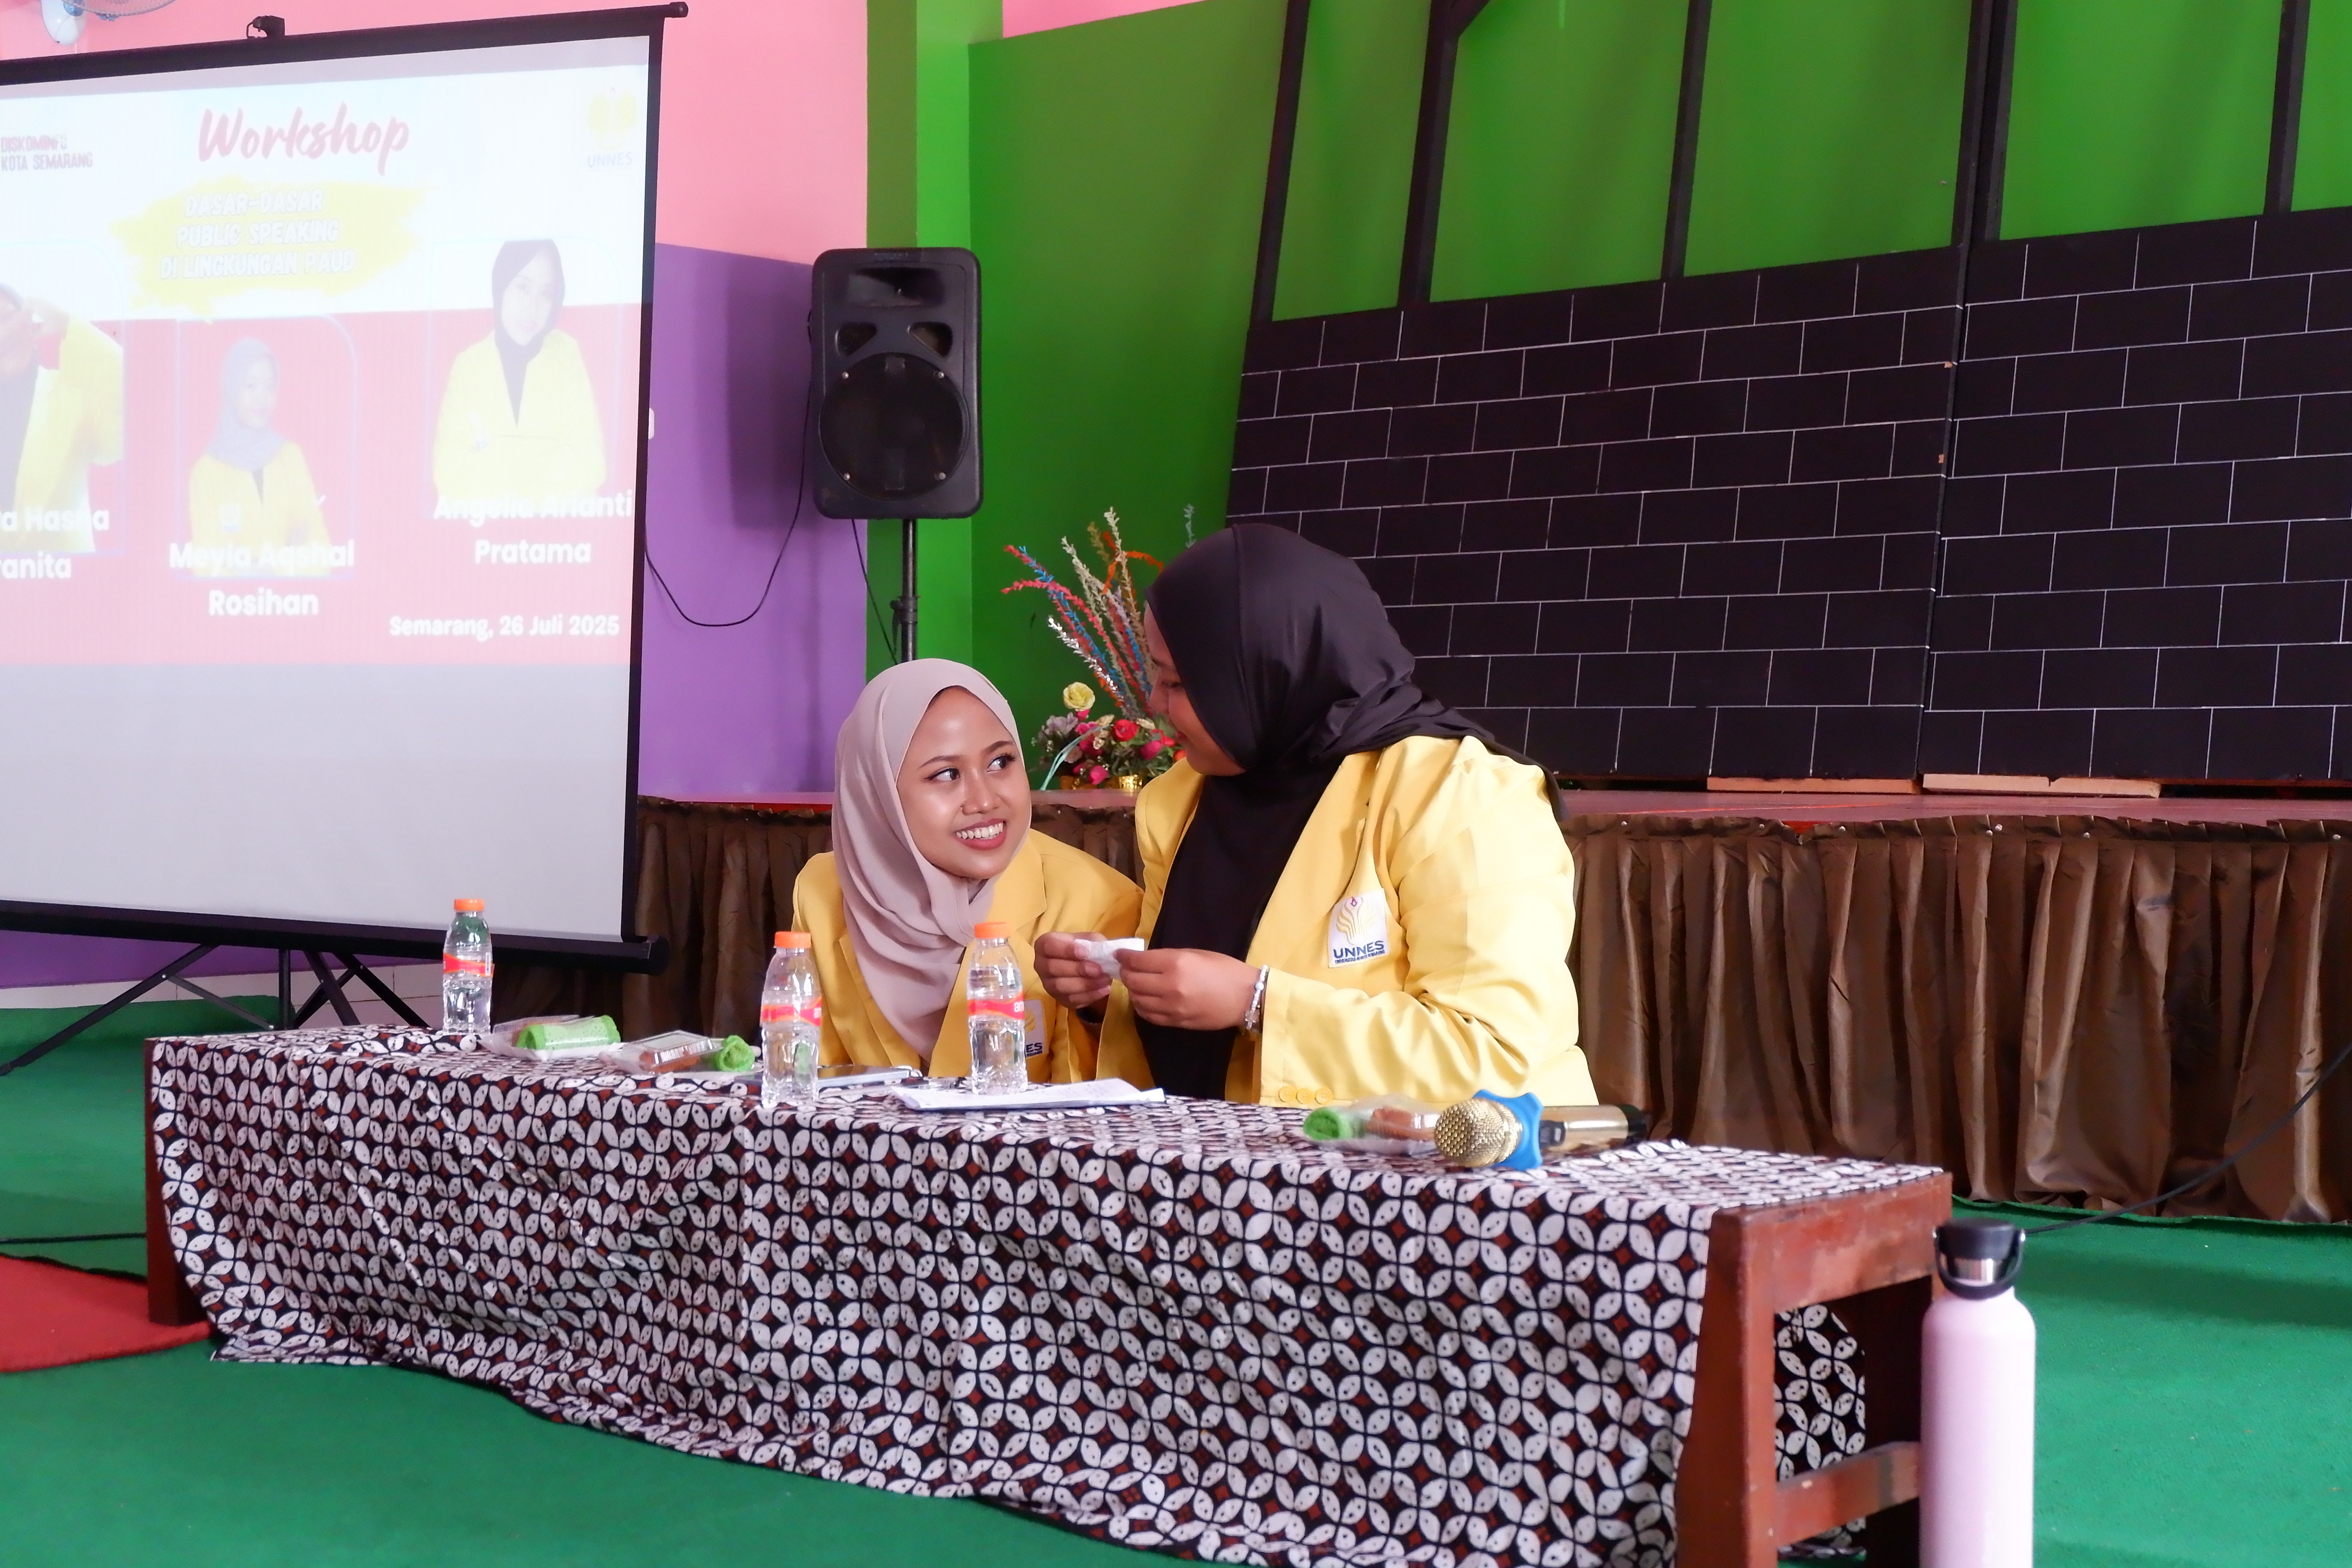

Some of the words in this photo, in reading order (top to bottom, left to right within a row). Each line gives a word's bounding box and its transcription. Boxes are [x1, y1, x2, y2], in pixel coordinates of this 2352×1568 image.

[198, 101, 410, 176] Workshop
[1, 155, 28, 171] KOTA
[33, 151, 93, 171] SEMARANG
[587, 151, 633, 168] UNNES
[185, 188, 325, 218] DASAR-DASAR
[176, 222, 242, 248] PUBLIC
[248, 219, 340, 245] SPEAKING
[160, 256, 178, 280] DI
[184, 251, 298, 279] LINGKUNGAN
[303, 249, 355, 274] PAUD
[433, 491, 534, 528] Angelia
[540, 489, 633, 518] Arianti
[0, 550, 72, 579] anita
[169, 541, 251, 577] Meyla
[257, 538, 355, 576] Aqshal
[475, 539, 591, 564] Pratama
[208, 586, 319, 616] Rosihan
[389, 615, 494, 642] Semarang,
[500, 614, 524, 637] 26
[529, 612, 564, 637] Juli
[569, 614, 620, 637] 2025
[1333, 940, 1384, 959] UNNES
